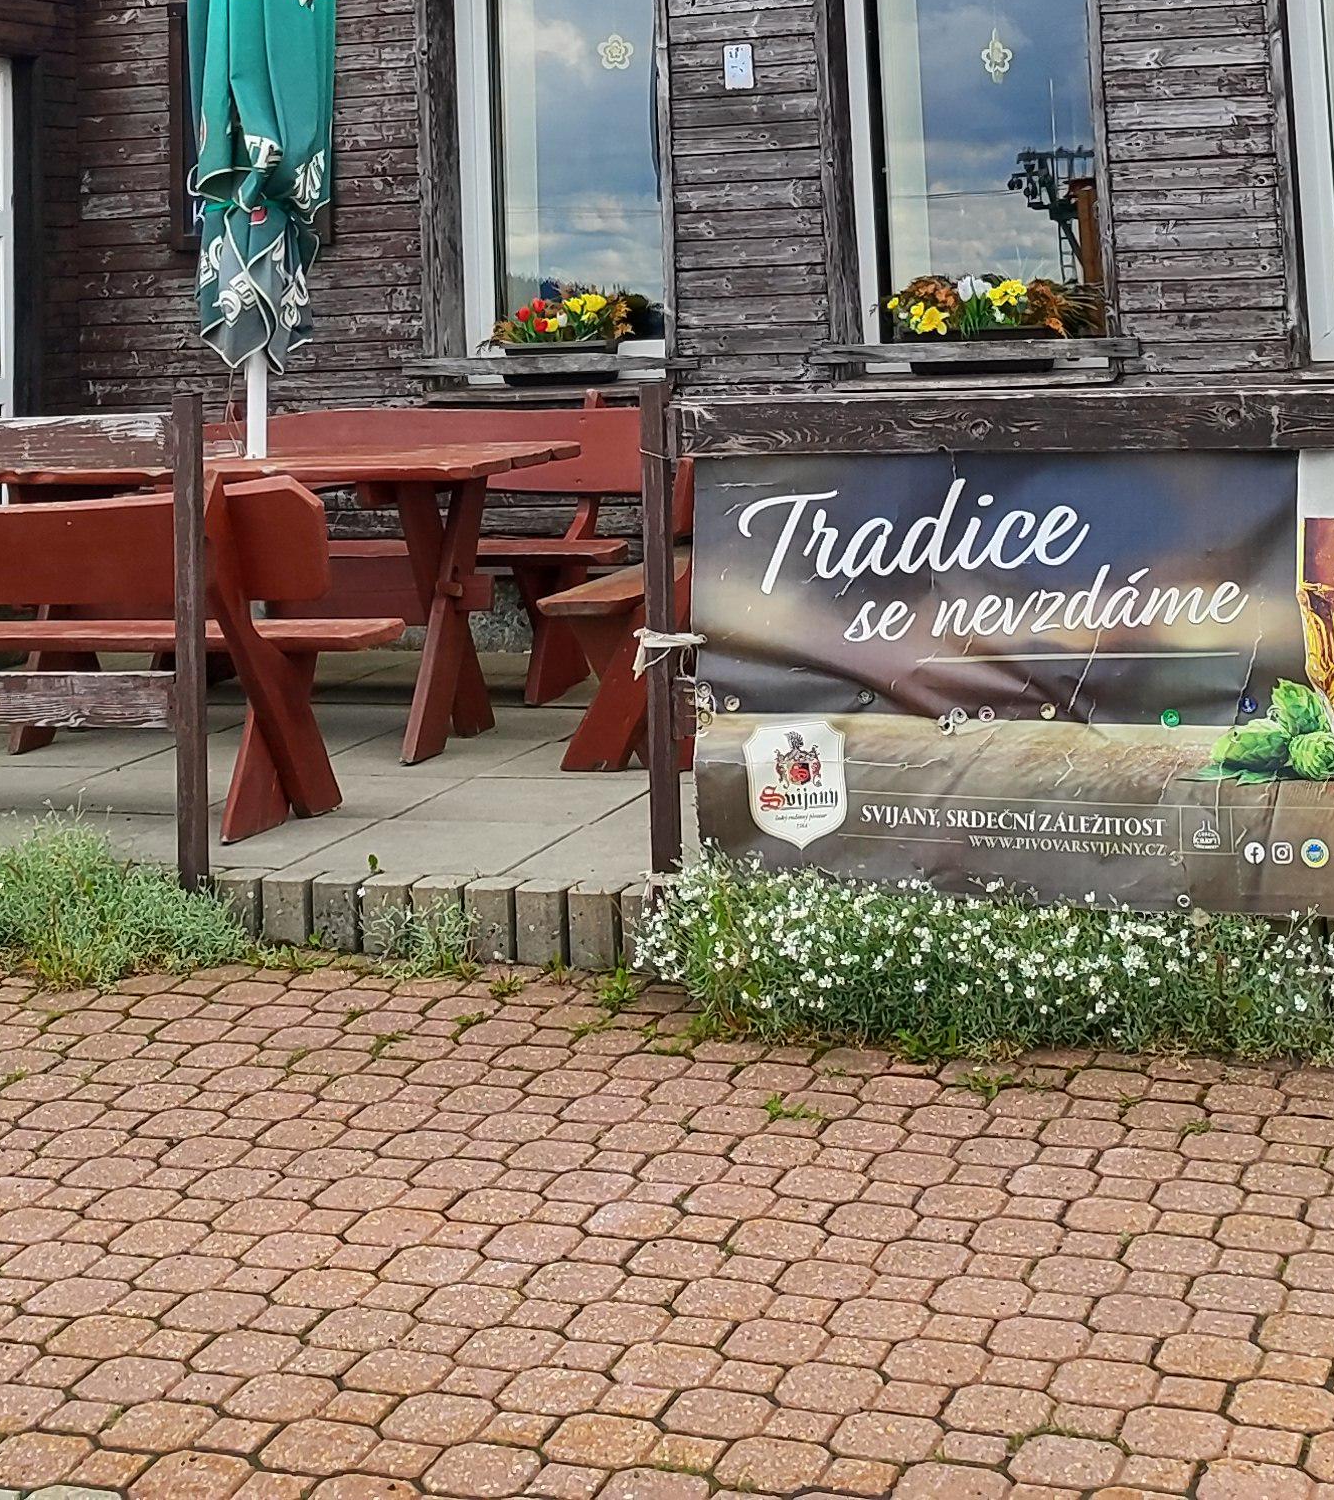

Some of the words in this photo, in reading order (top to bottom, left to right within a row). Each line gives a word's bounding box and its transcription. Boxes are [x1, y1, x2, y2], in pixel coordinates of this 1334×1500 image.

[737, 477, 1091, 595] Tradice
[842, 598, 917, 642] se
[930, 563, 1249, 638] nevzdáme
[759, 785, 839, 811] Svijany
[859, 803, 942, 829] SVIJANY,
[945, 808, 1036, 833] SRDEČNÍ
[1038, 811, 1166, 838] ZÁLEŽITOST
[967, 834, 1167, 858] WWW.PIVOVARSVIJANY.CZ
